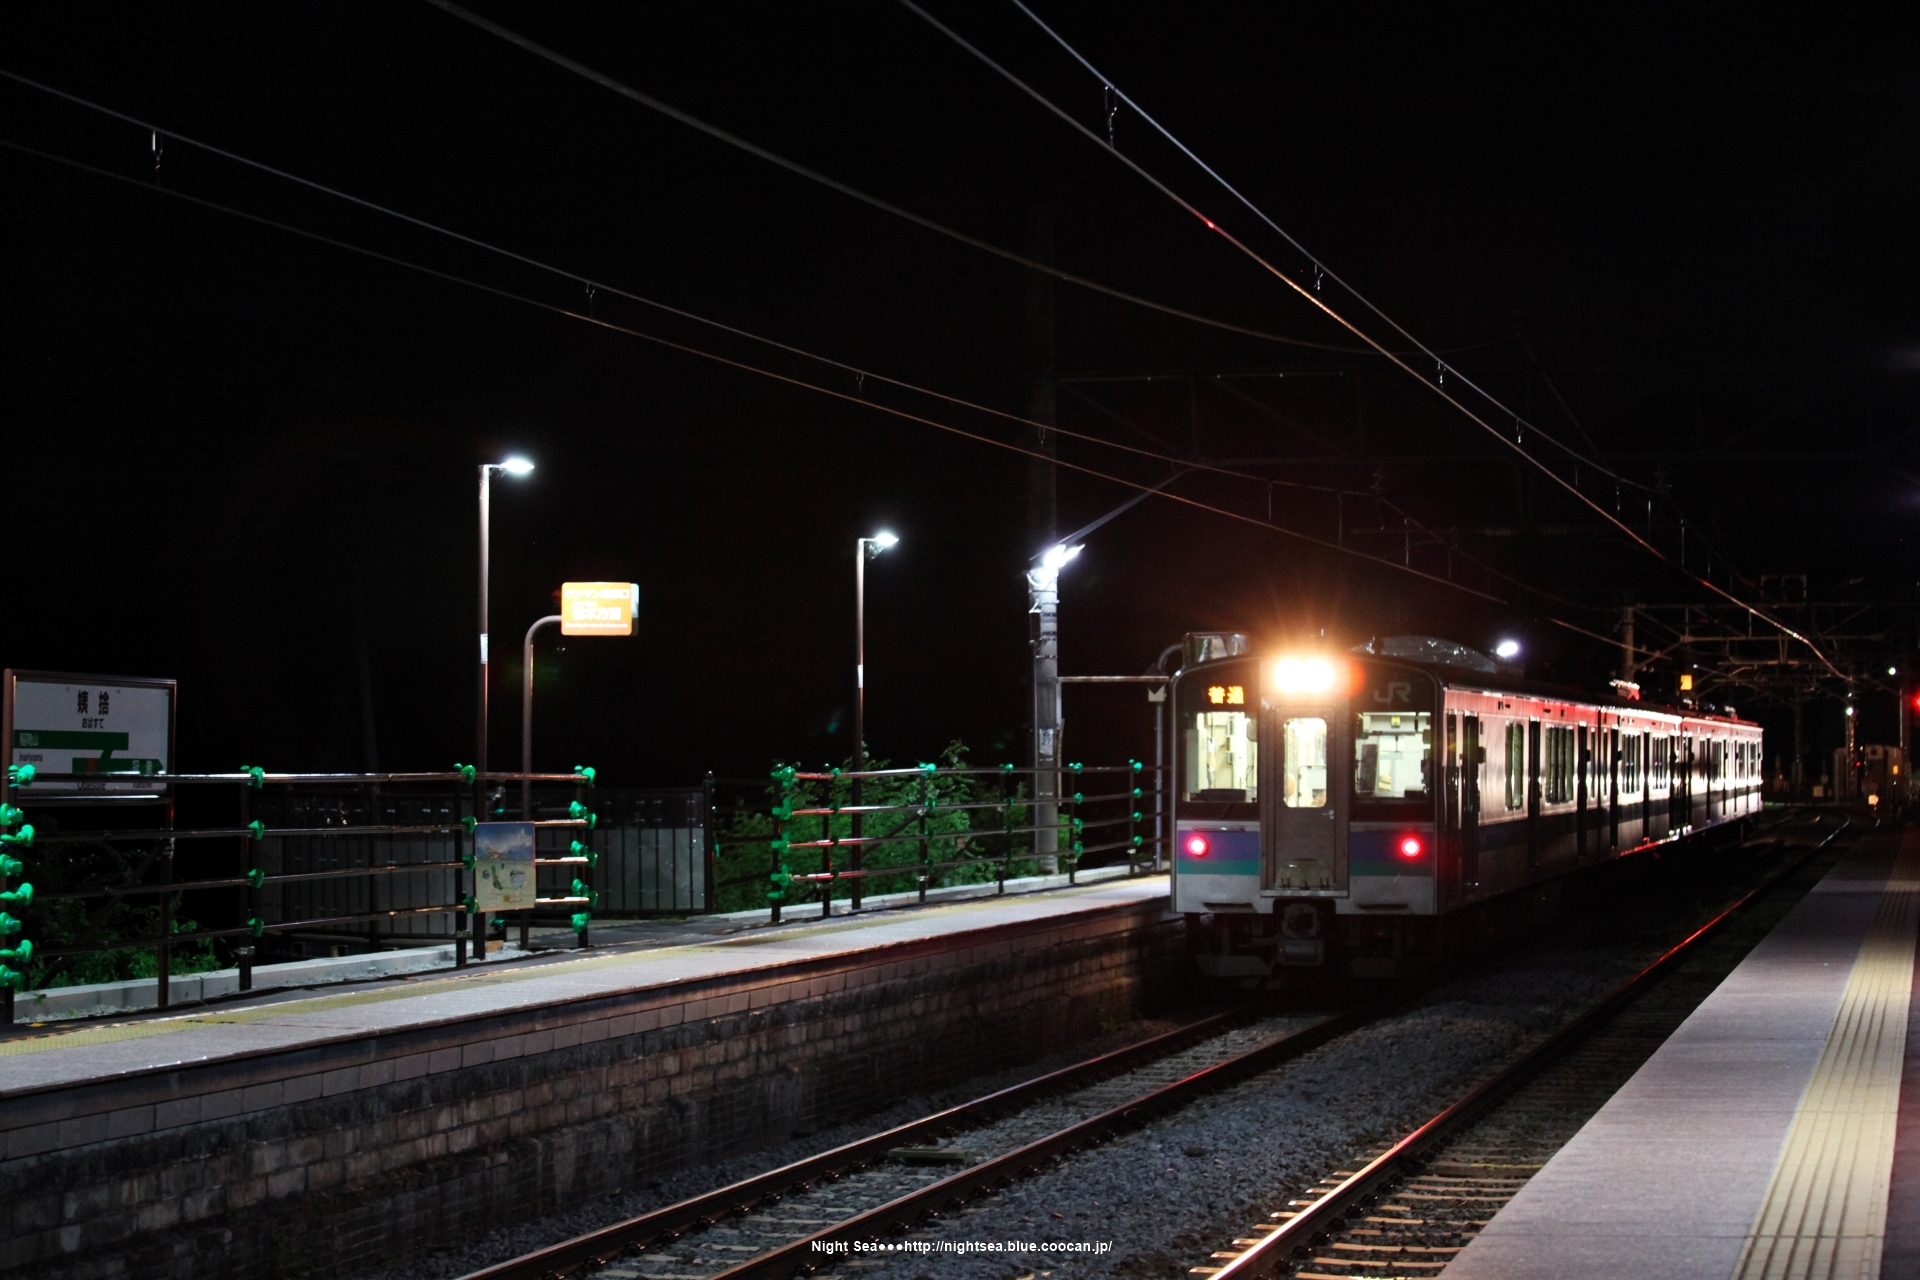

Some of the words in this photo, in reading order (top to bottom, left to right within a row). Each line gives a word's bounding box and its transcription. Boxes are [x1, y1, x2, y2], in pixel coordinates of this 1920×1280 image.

[1208, 686, 1244, 704] 普通
[1373, 682, 1411, 704] JR
[82, 717, 104, 729] おばすて
